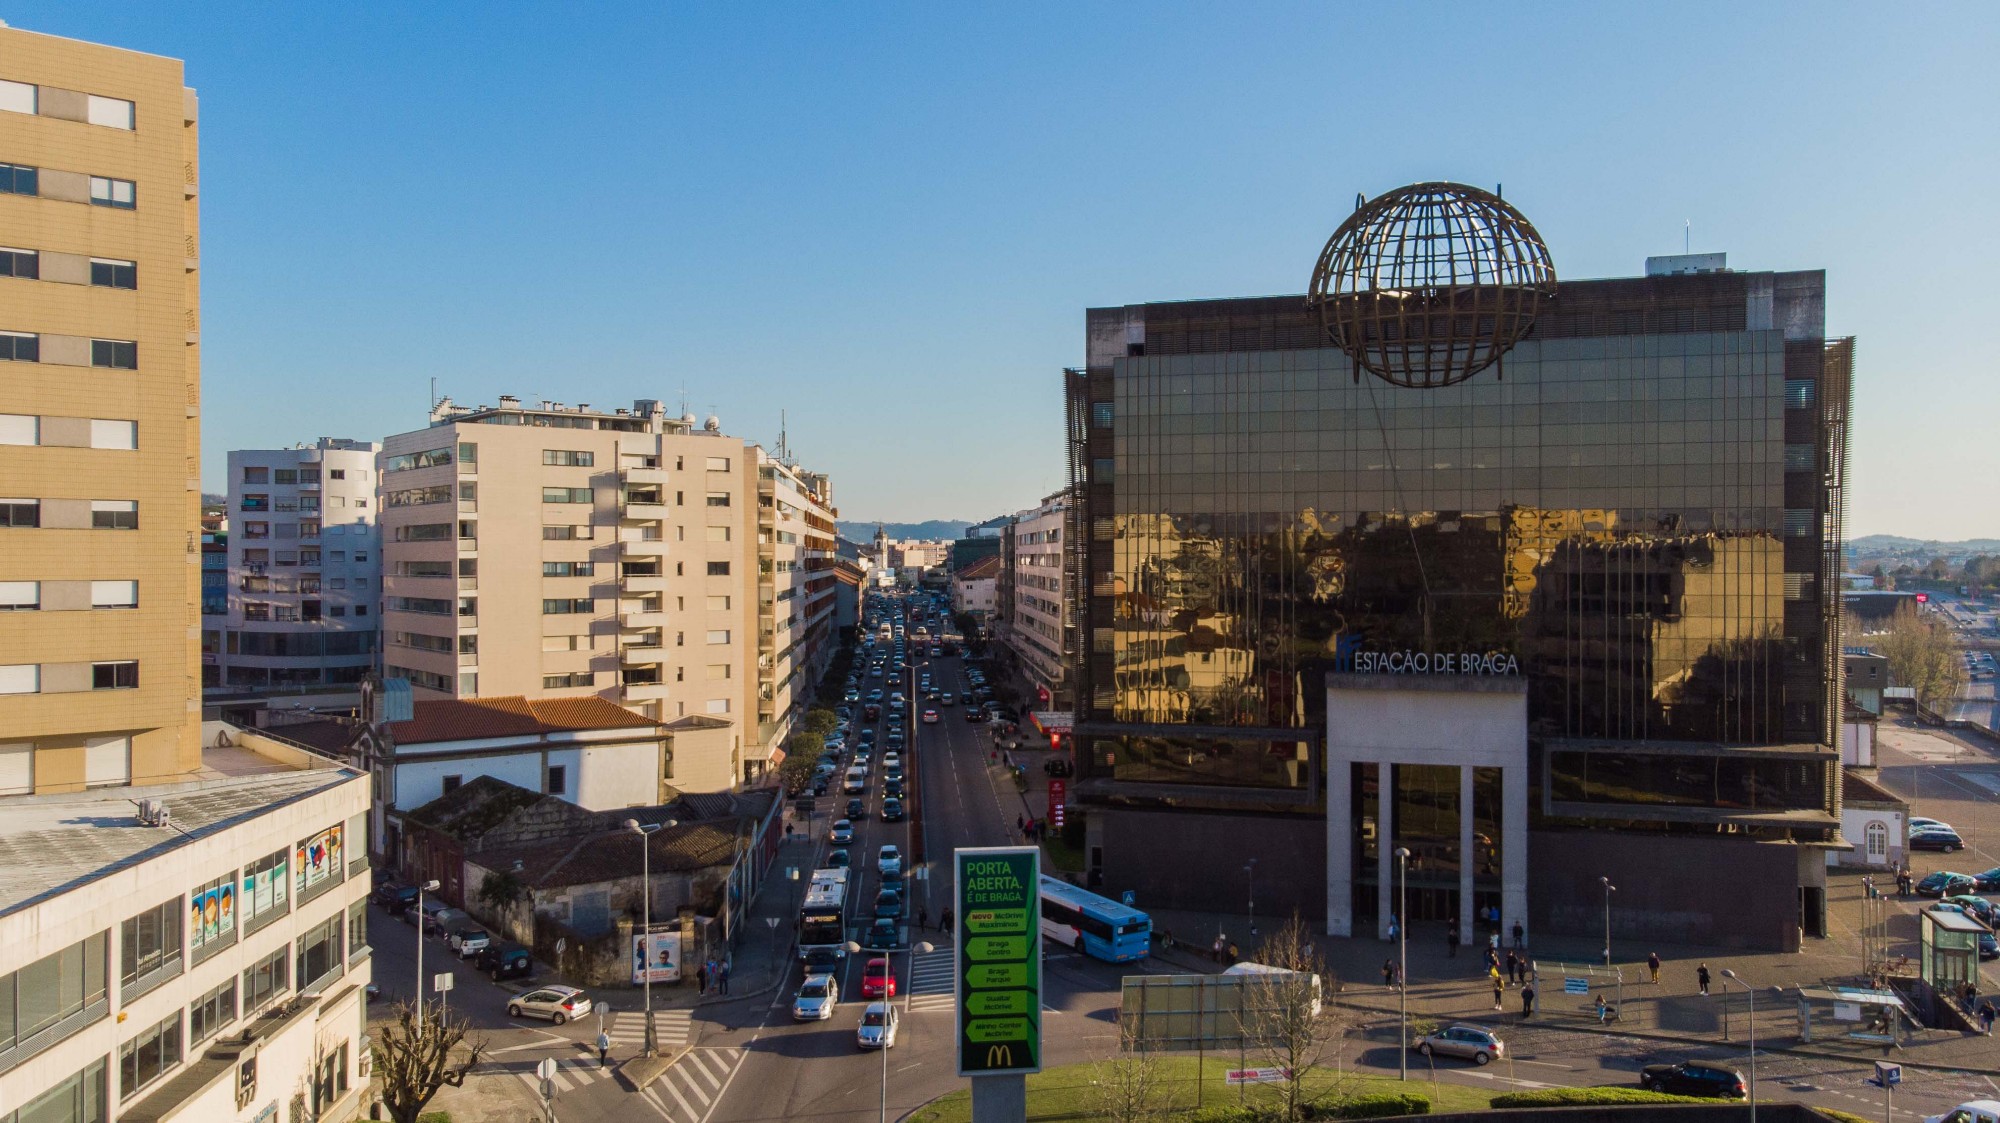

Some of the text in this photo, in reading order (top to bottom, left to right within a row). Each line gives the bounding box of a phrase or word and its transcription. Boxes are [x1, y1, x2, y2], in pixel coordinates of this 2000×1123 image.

[1355, 650, 1518, 673] ESTAÇÃO DE BRAGA
[967, 862, 1011, 875] PORTA
[968, 877, 1023, 890] ABERTA.
[968, 891, 1023, 902] É DE BRAGA.
